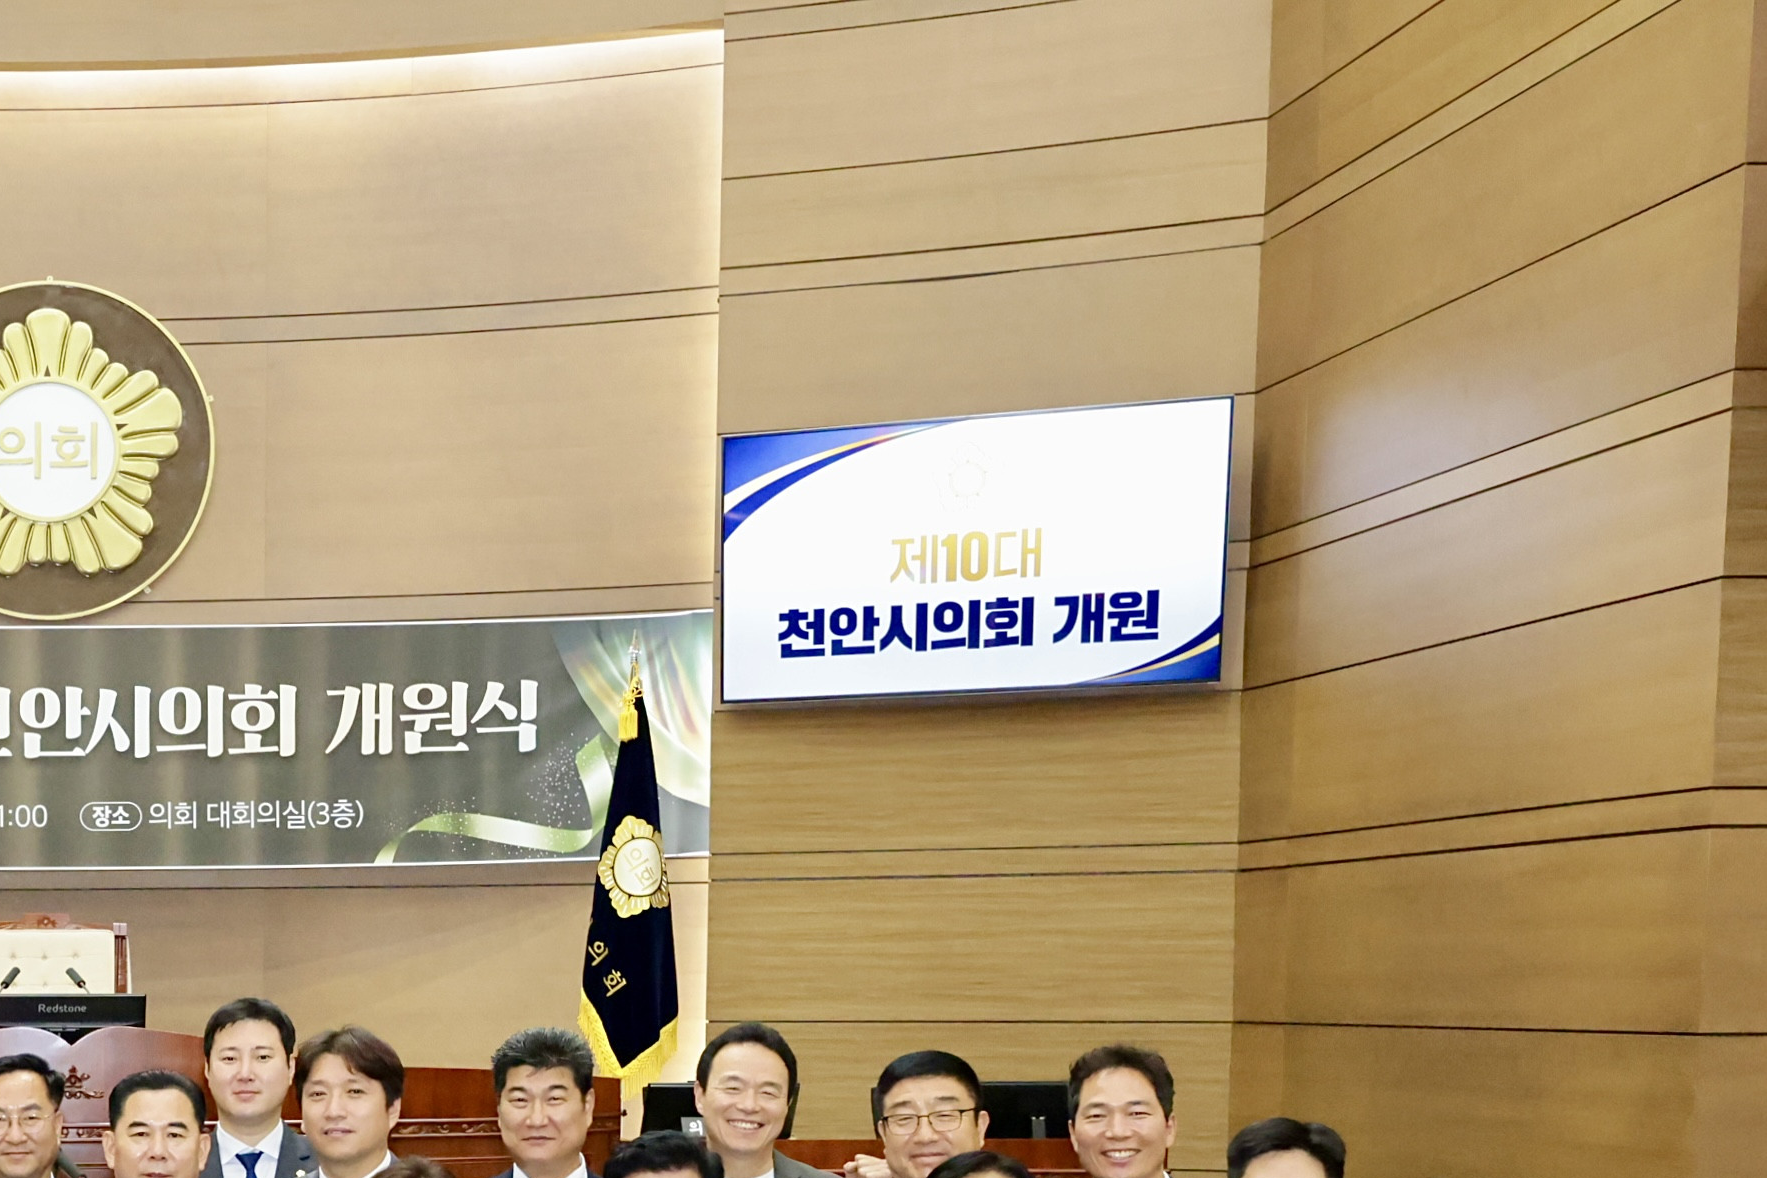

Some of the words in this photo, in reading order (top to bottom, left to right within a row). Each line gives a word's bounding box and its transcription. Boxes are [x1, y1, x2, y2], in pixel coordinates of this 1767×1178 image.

[889, 527, 1043, 584] 제10대
[778, 597, 1034, 659] 천안시의회
[1053, 590, 1160, 644] 개원
[325, 679, 539, 755] 개원식
[92, 804, 131, 828] 장소
[148, 801, 197, 830] 의회
[206, 799, 364, 830] 대회의실(3층)
[37, 1002, 87, 1014] Redstone
